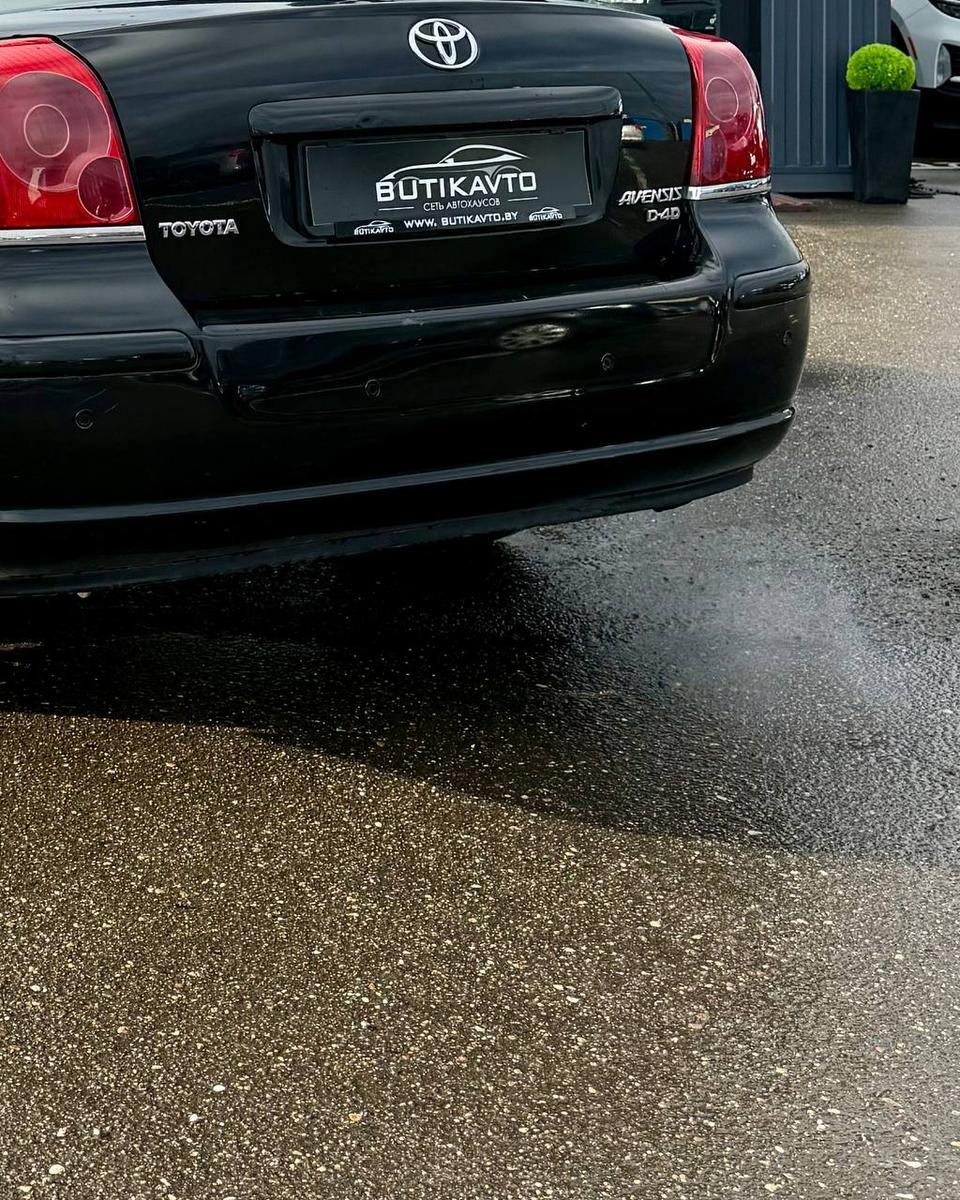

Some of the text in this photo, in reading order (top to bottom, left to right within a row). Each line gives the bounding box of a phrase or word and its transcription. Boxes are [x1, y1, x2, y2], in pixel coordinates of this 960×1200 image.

[375, 171, 538, 203] BUTIKAVTO
[618, 186, 683, 206] AVENSIS
[423, 198, 501, 212] СЕТЬ АВТОХАУСОВ
[403, 211, 519, 229] WWW. BUTIKAVTO.BY
[528, 211, 564, 222] BUTIKAVTO
[646, 206, 681, 222] D-4D
[158, 218, 240, 238] TOYOTA
[353, 226, 395, 236] BUTIKAVTO
